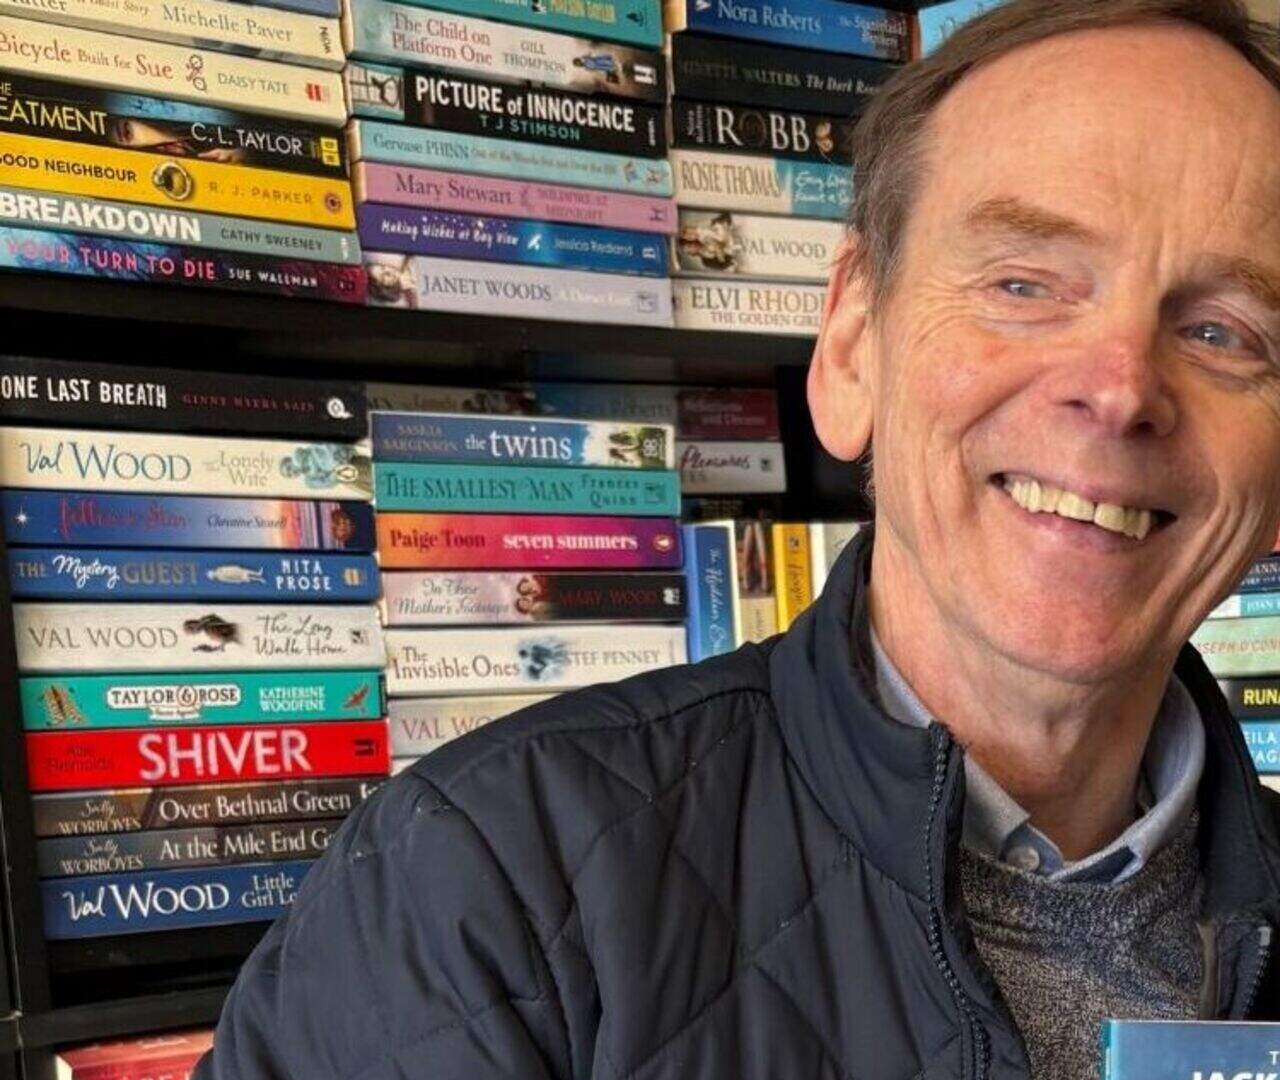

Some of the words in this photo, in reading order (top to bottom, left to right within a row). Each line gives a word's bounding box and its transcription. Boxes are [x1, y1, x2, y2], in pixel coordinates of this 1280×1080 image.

[392, 12, 423, 35] The
[426, 20, 468, 44] Child
[762, 5, 821, 34] Roberts
[391, 34, 456, 63] Platform
[135, 55, 175, 80] Sue
[416, 77, 503, 113] PICTURE
[507, 95, 524, 115] of
[526, 93, 636, 133] INNOCENCE
[236, 128, 303, 157] TAYLOR
[509, 119, 581, 142] STIMSON
[45, 158, 137, 184] NEIGHBOUR
[394, 172, 444, 200] Mary
[446, 178, 513, 206] Stewart
[0, 192, 202, 243] BREAKDOWN
[774, 239, 827, 258] WOOD
[79, 246, 137, 272] TURN
[146, 256, 175, 276] TO
[183, 258, 216, 281] DIE
[422, 273, 482, 302] JANET
[484, 276, 552, 302] WOODS
[691, 286, 742, 311] ELVI
[0, 376, 38, 399] ONE
[47, 378, 90, 403] LAST
[99, 380, 168, 409] BREATH
[489, 425, 573, 462] twins
[69, 441, 192, 482] WOOD
[424, 472, 518, 501] SMALLEST
[526, 476, 575, 500] MAN
[390, 530, 438, 549] Paige
[441, 532, 487, 548] Toon
[503, 531, 554, 549] seven
[556, 531, 640, 551] summers
[275, 573, 333, 592] PROSE
[280, 559, 325, 577] NITA
[28, 627, 81, 650] VAL
[83, 627, 180, 650] WOOD
[390, 655, 471, 682] Invisible
[111, 690, 175, 706] TAYLOR
[199, 687, 239, 704] ROSE
[402, 717, 449, 741] VAL
[138, 729, 314, 782] SHIVER
[158, 798, 212, 824] Over
[216, 793, 289, 819] Bethnal
[291, 790, 353, 813] Green
[160, 839, 181, 862] At
[183, 840, 220, 861] the
[223, 831, 268, 858] Mile
[270, 828, 307, 854] End
[62, 886, 106, 922] Val
[108, 881, 231, 920] WOOD
